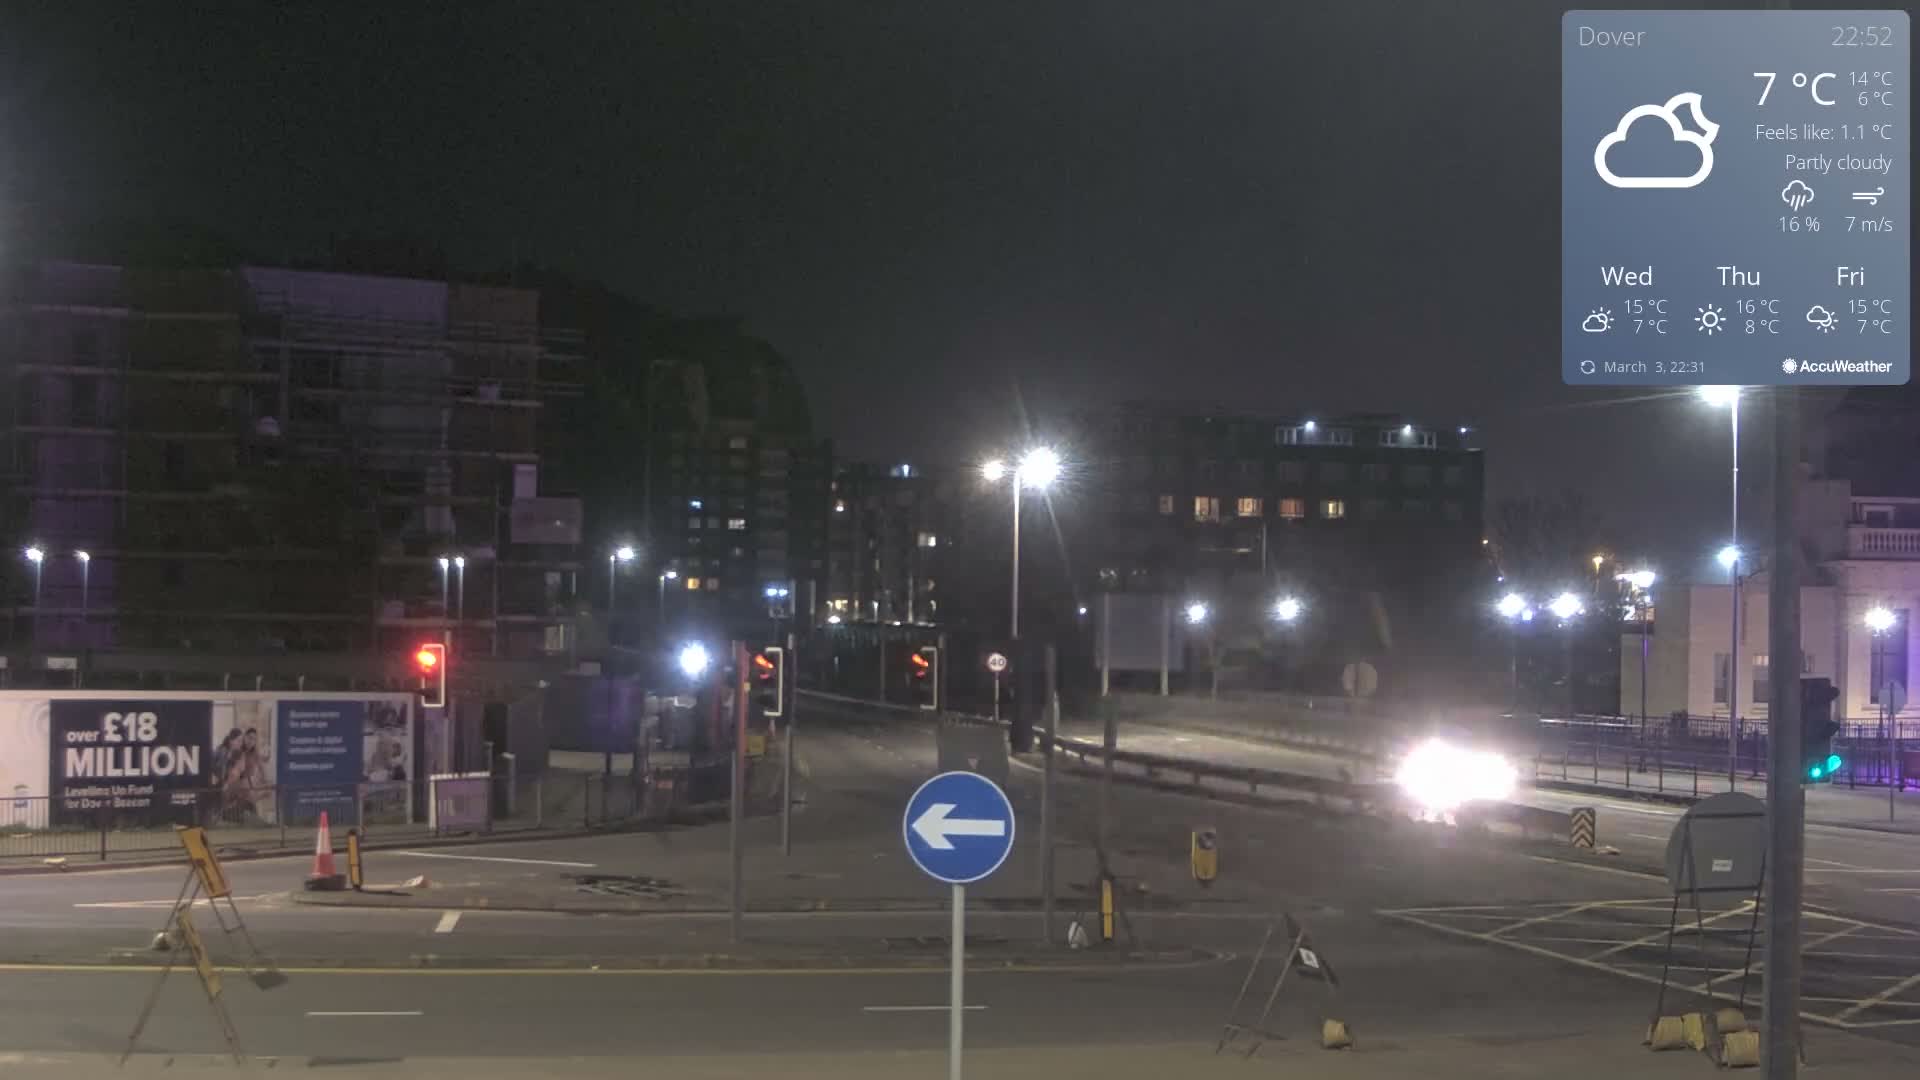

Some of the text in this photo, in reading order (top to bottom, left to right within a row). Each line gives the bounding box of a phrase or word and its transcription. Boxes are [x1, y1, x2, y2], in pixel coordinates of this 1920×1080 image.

[990, 656, 1005, 667] 40
[66, 711, 158, 742] over £18
[66, 745, 200, 777] MILLION
